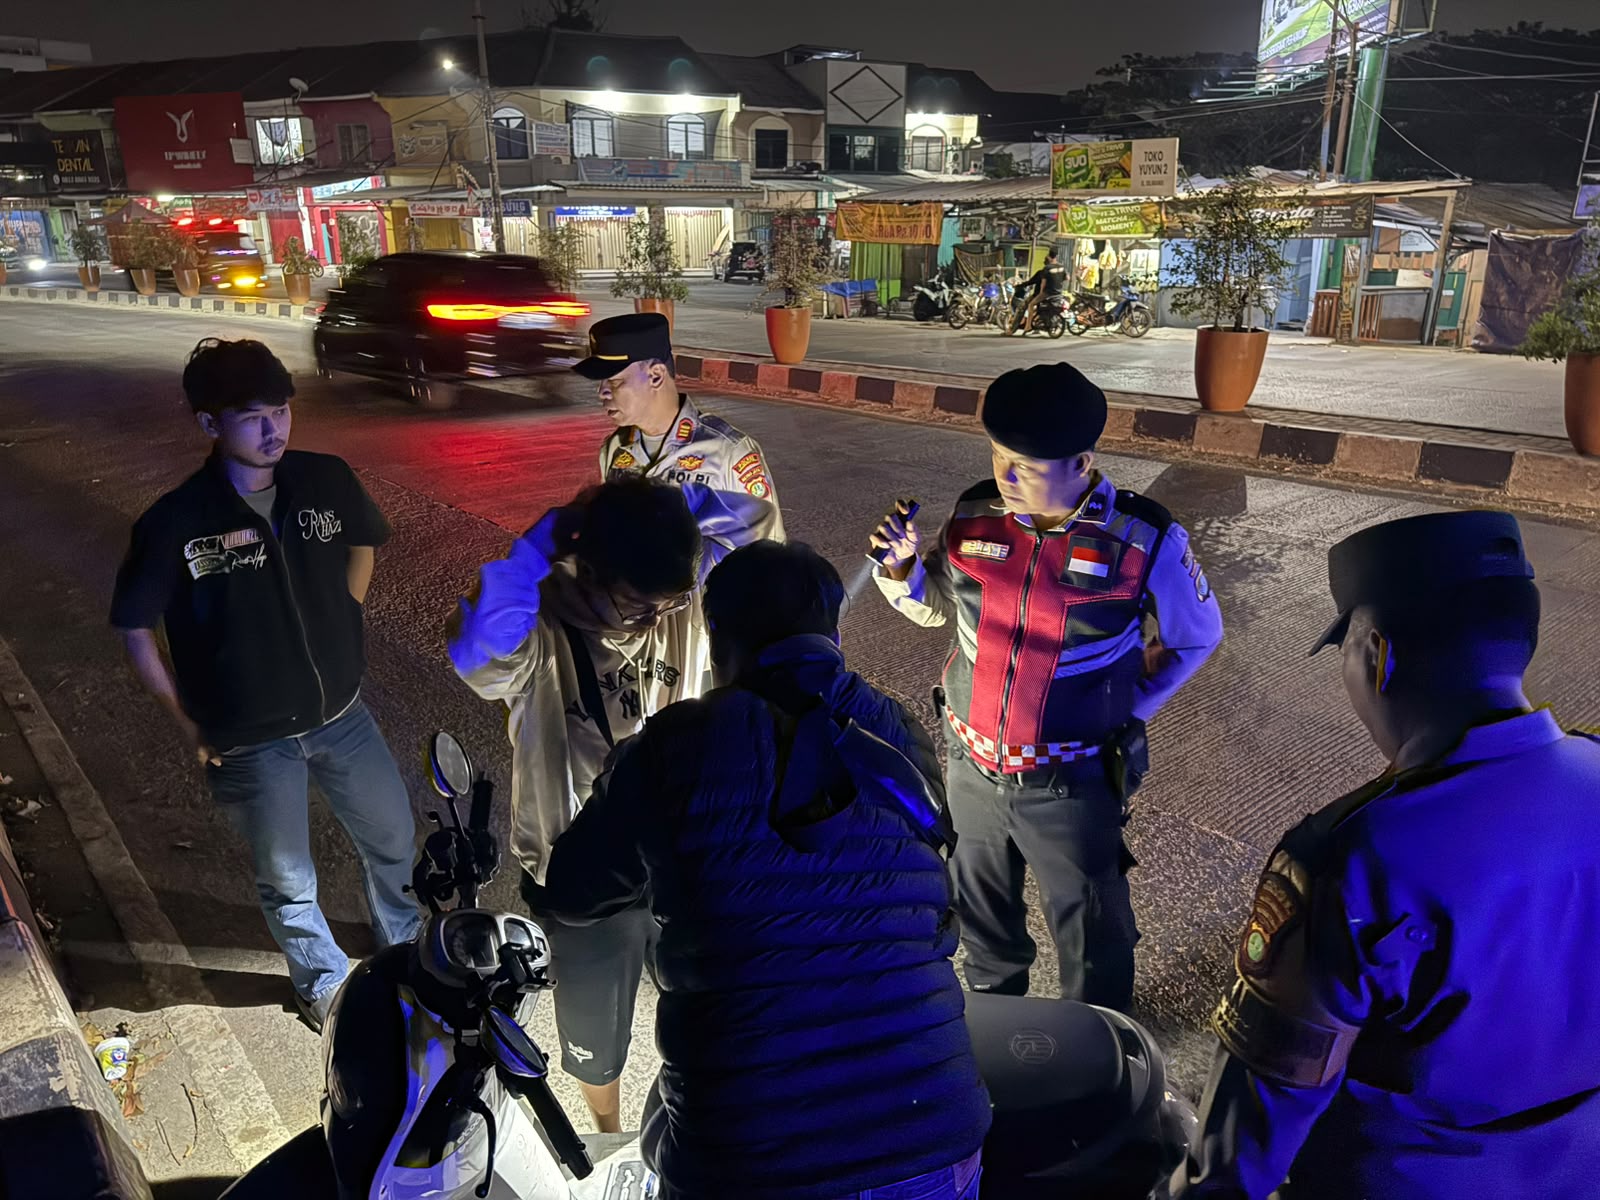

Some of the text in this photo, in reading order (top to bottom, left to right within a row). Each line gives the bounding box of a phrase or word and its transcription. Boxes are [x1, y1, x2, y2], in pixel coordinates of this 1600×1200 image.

[51, 139, 91, 153] TEAN
[1144, 151, 1164, 161] TOKO
[57, 158, 94, 172] DENTAL
[1139, 164, 1168, 175] YUYUN 2
[1096, 215, 1128, 225] MATCHA
[1100, 221, 1135, 232] MOMENT
